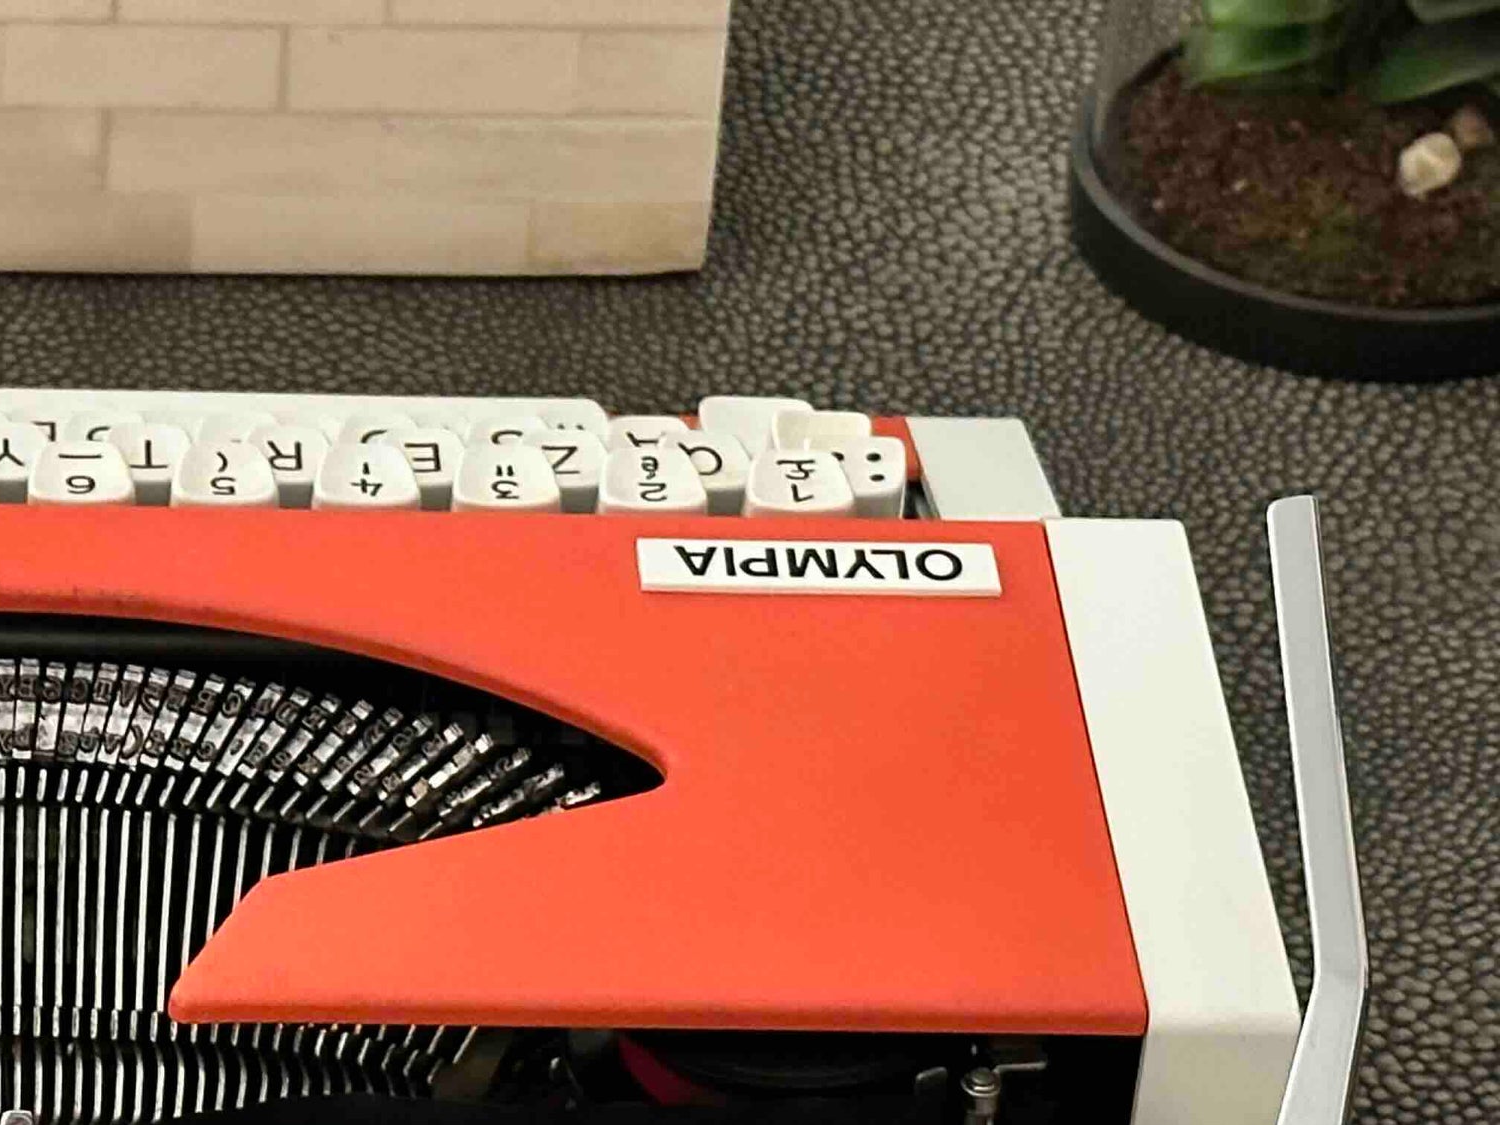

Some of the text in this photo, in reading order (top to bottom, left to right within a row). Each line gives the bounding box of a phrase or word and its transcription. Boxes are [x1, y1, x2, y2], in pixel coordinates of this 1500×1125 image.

[128, 439, 169, 469] T
[266, 440, 304, 472] R
[404, 441, 442, 473] E
[540, 445, 581, 475] Z
[677, 442, 724, 476] Q
[65, 475, 97, 494] 6
[209, 476, 237, 496] 5
[349, 477, 384, 497] 4
[489, 480, 520, 500] 3
[637, 482, 668, 502] 2
[790, 482, 815, 503] 1
[673, 545, 964, 582] OLYMPIA
